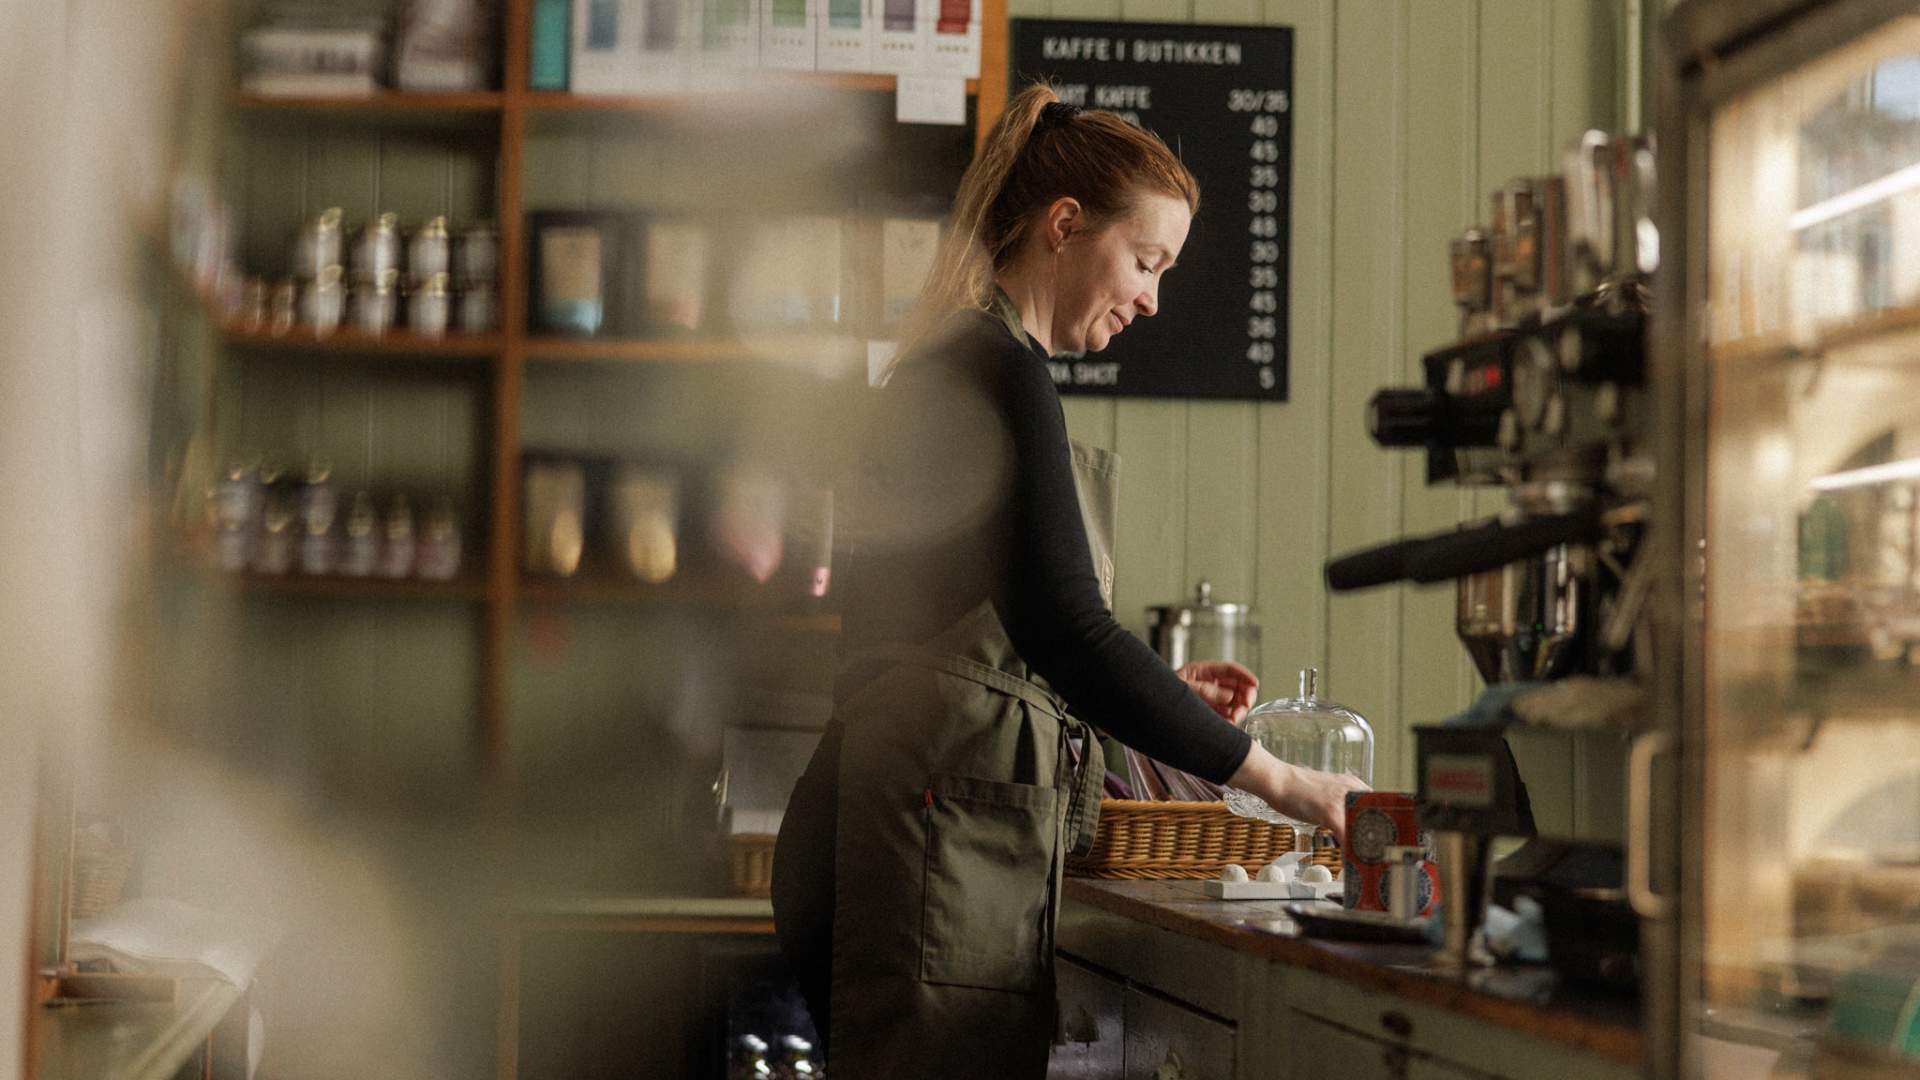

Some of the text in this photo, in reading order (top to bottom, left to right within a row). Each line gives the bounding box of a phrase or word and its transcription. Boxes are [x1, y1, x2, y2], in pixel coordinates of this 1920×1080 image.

[1044, 38, 1241, 64] KAFFE I BUTIKKEN
[1095, 86, 1150, 109] KAFFE
